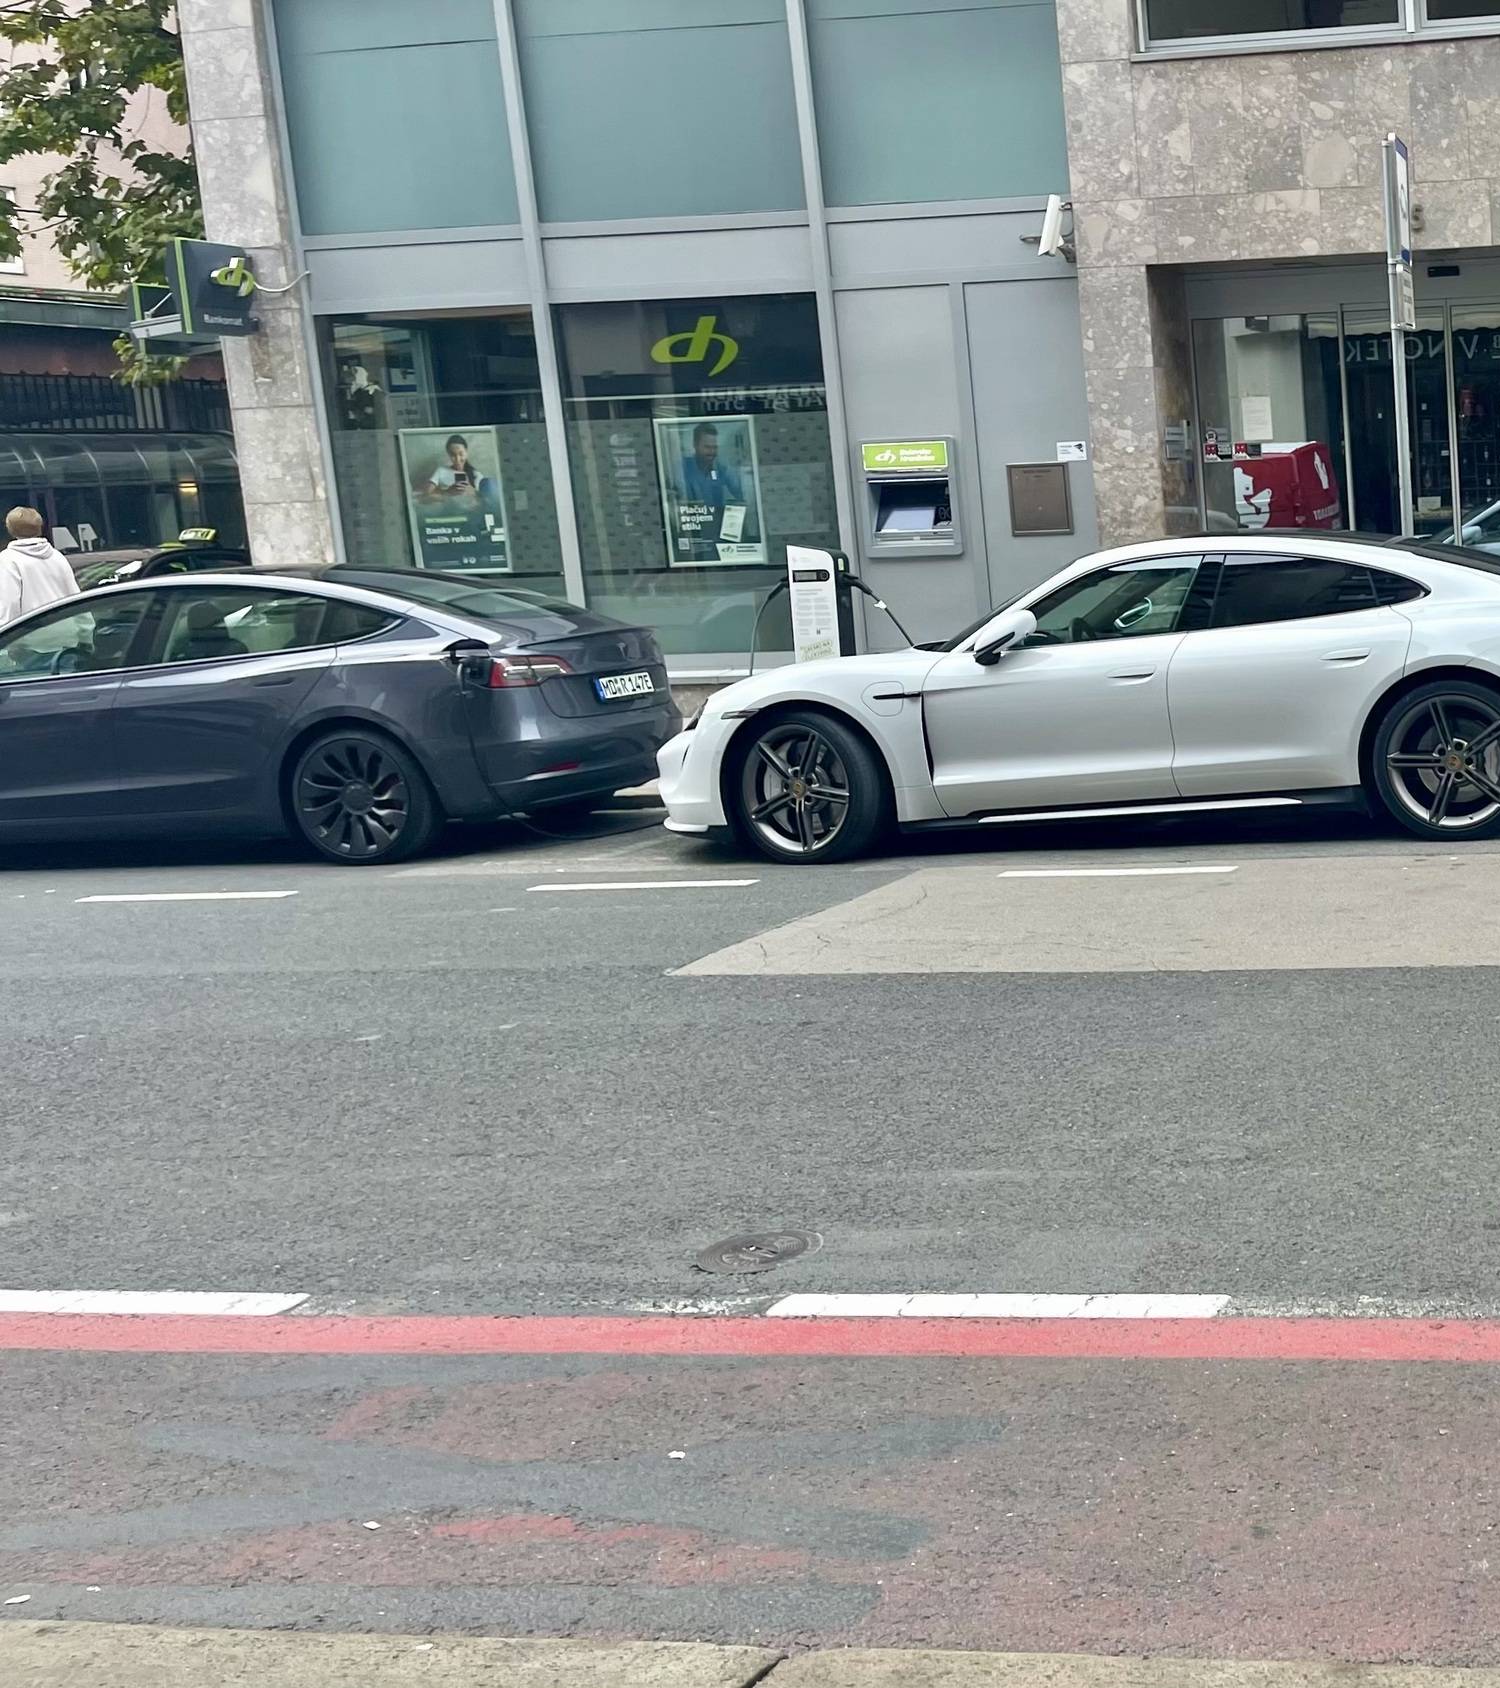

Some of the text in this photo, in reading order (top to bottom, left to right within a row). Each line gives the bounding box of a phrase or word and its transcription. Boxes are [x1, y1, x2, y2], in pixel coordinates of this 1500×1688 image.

[680, 505, 707, 514] Plačuj
[681, 514, 713, 523] svojem
[682, 522, 701, 531] stilu
